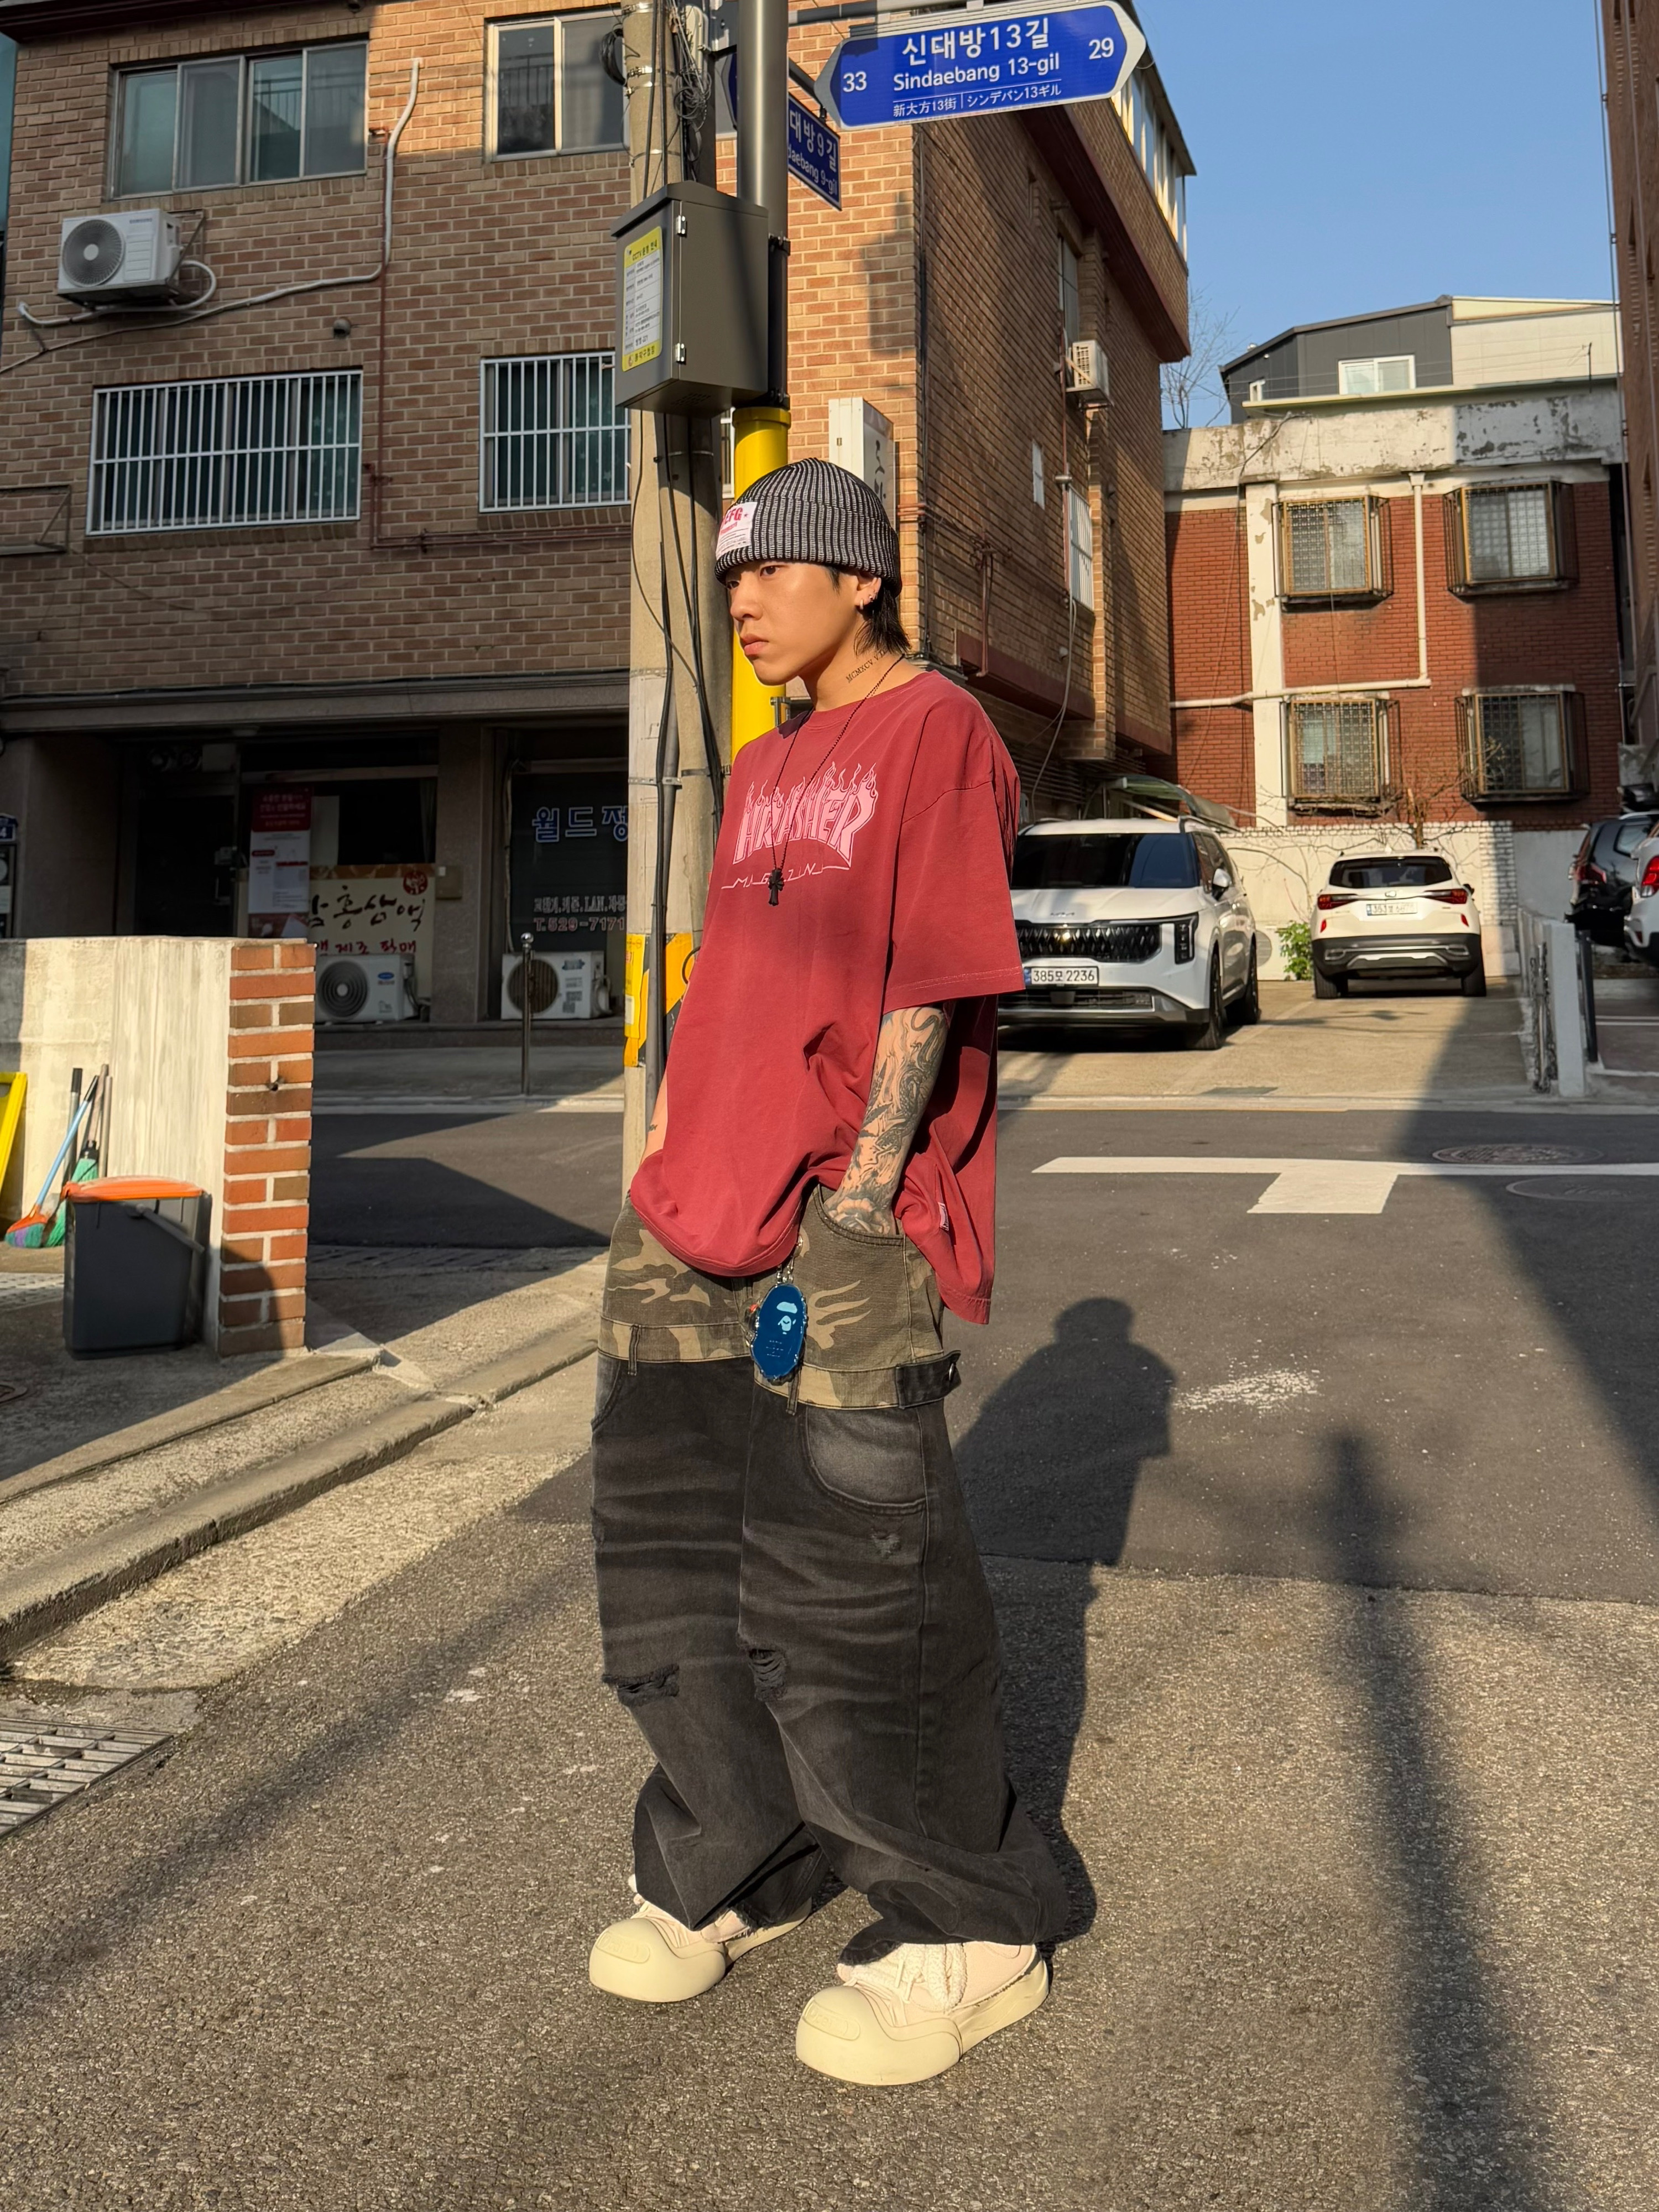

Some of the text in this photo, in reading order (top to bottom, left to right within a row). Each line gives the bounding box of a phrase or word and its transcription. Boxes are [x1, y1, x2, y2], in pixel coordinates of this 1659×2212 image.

[902, 17, 1049, 66] 신대방13길
[1088, 38, 1114, 61] 29
[843, 71, 867, 92] 33
[894, 53, 1060, 91] Sindaebang 13-gil
[893, 96, 957, 118] 新大方13街
[1066, 969, 1095, 982] 2236
